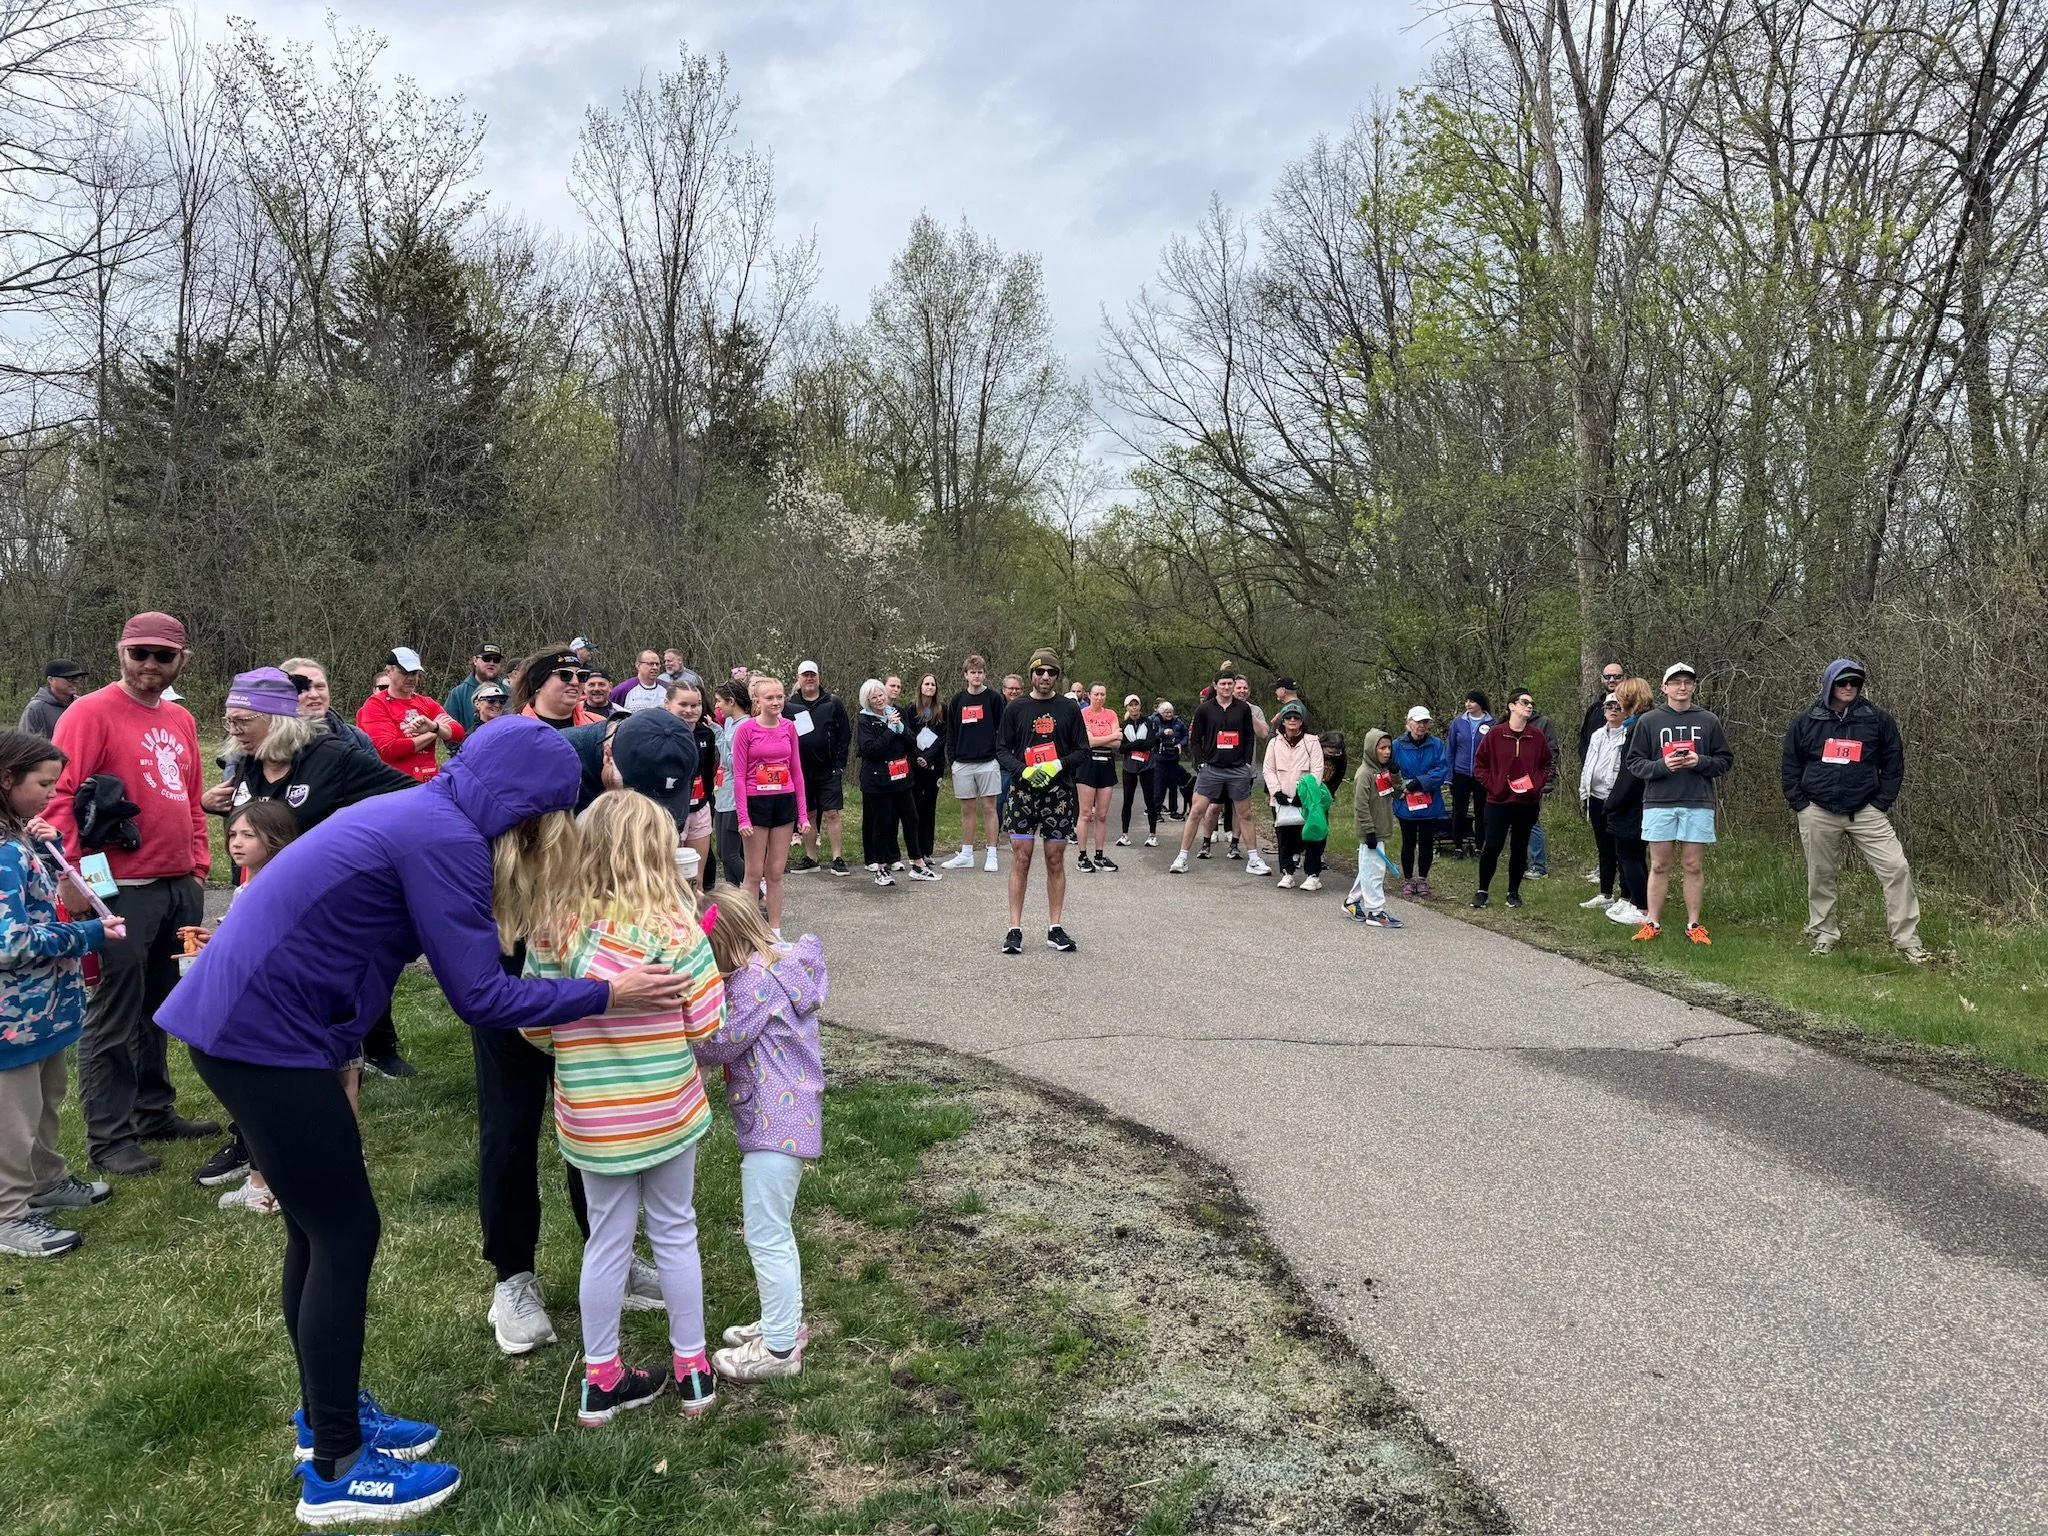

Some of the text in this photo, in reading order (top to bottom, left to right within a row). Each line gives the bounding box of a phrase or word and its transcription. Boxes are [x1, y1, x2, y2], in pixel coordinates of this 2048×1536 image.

[1034, 752, 1047, 764] 61
[1836, 747, 1850, 758] 18
[767, 771, 780, 783] 34
[1417, 796, 1423, 804] 6
[347, 1480, 395, 1498] HOKA
